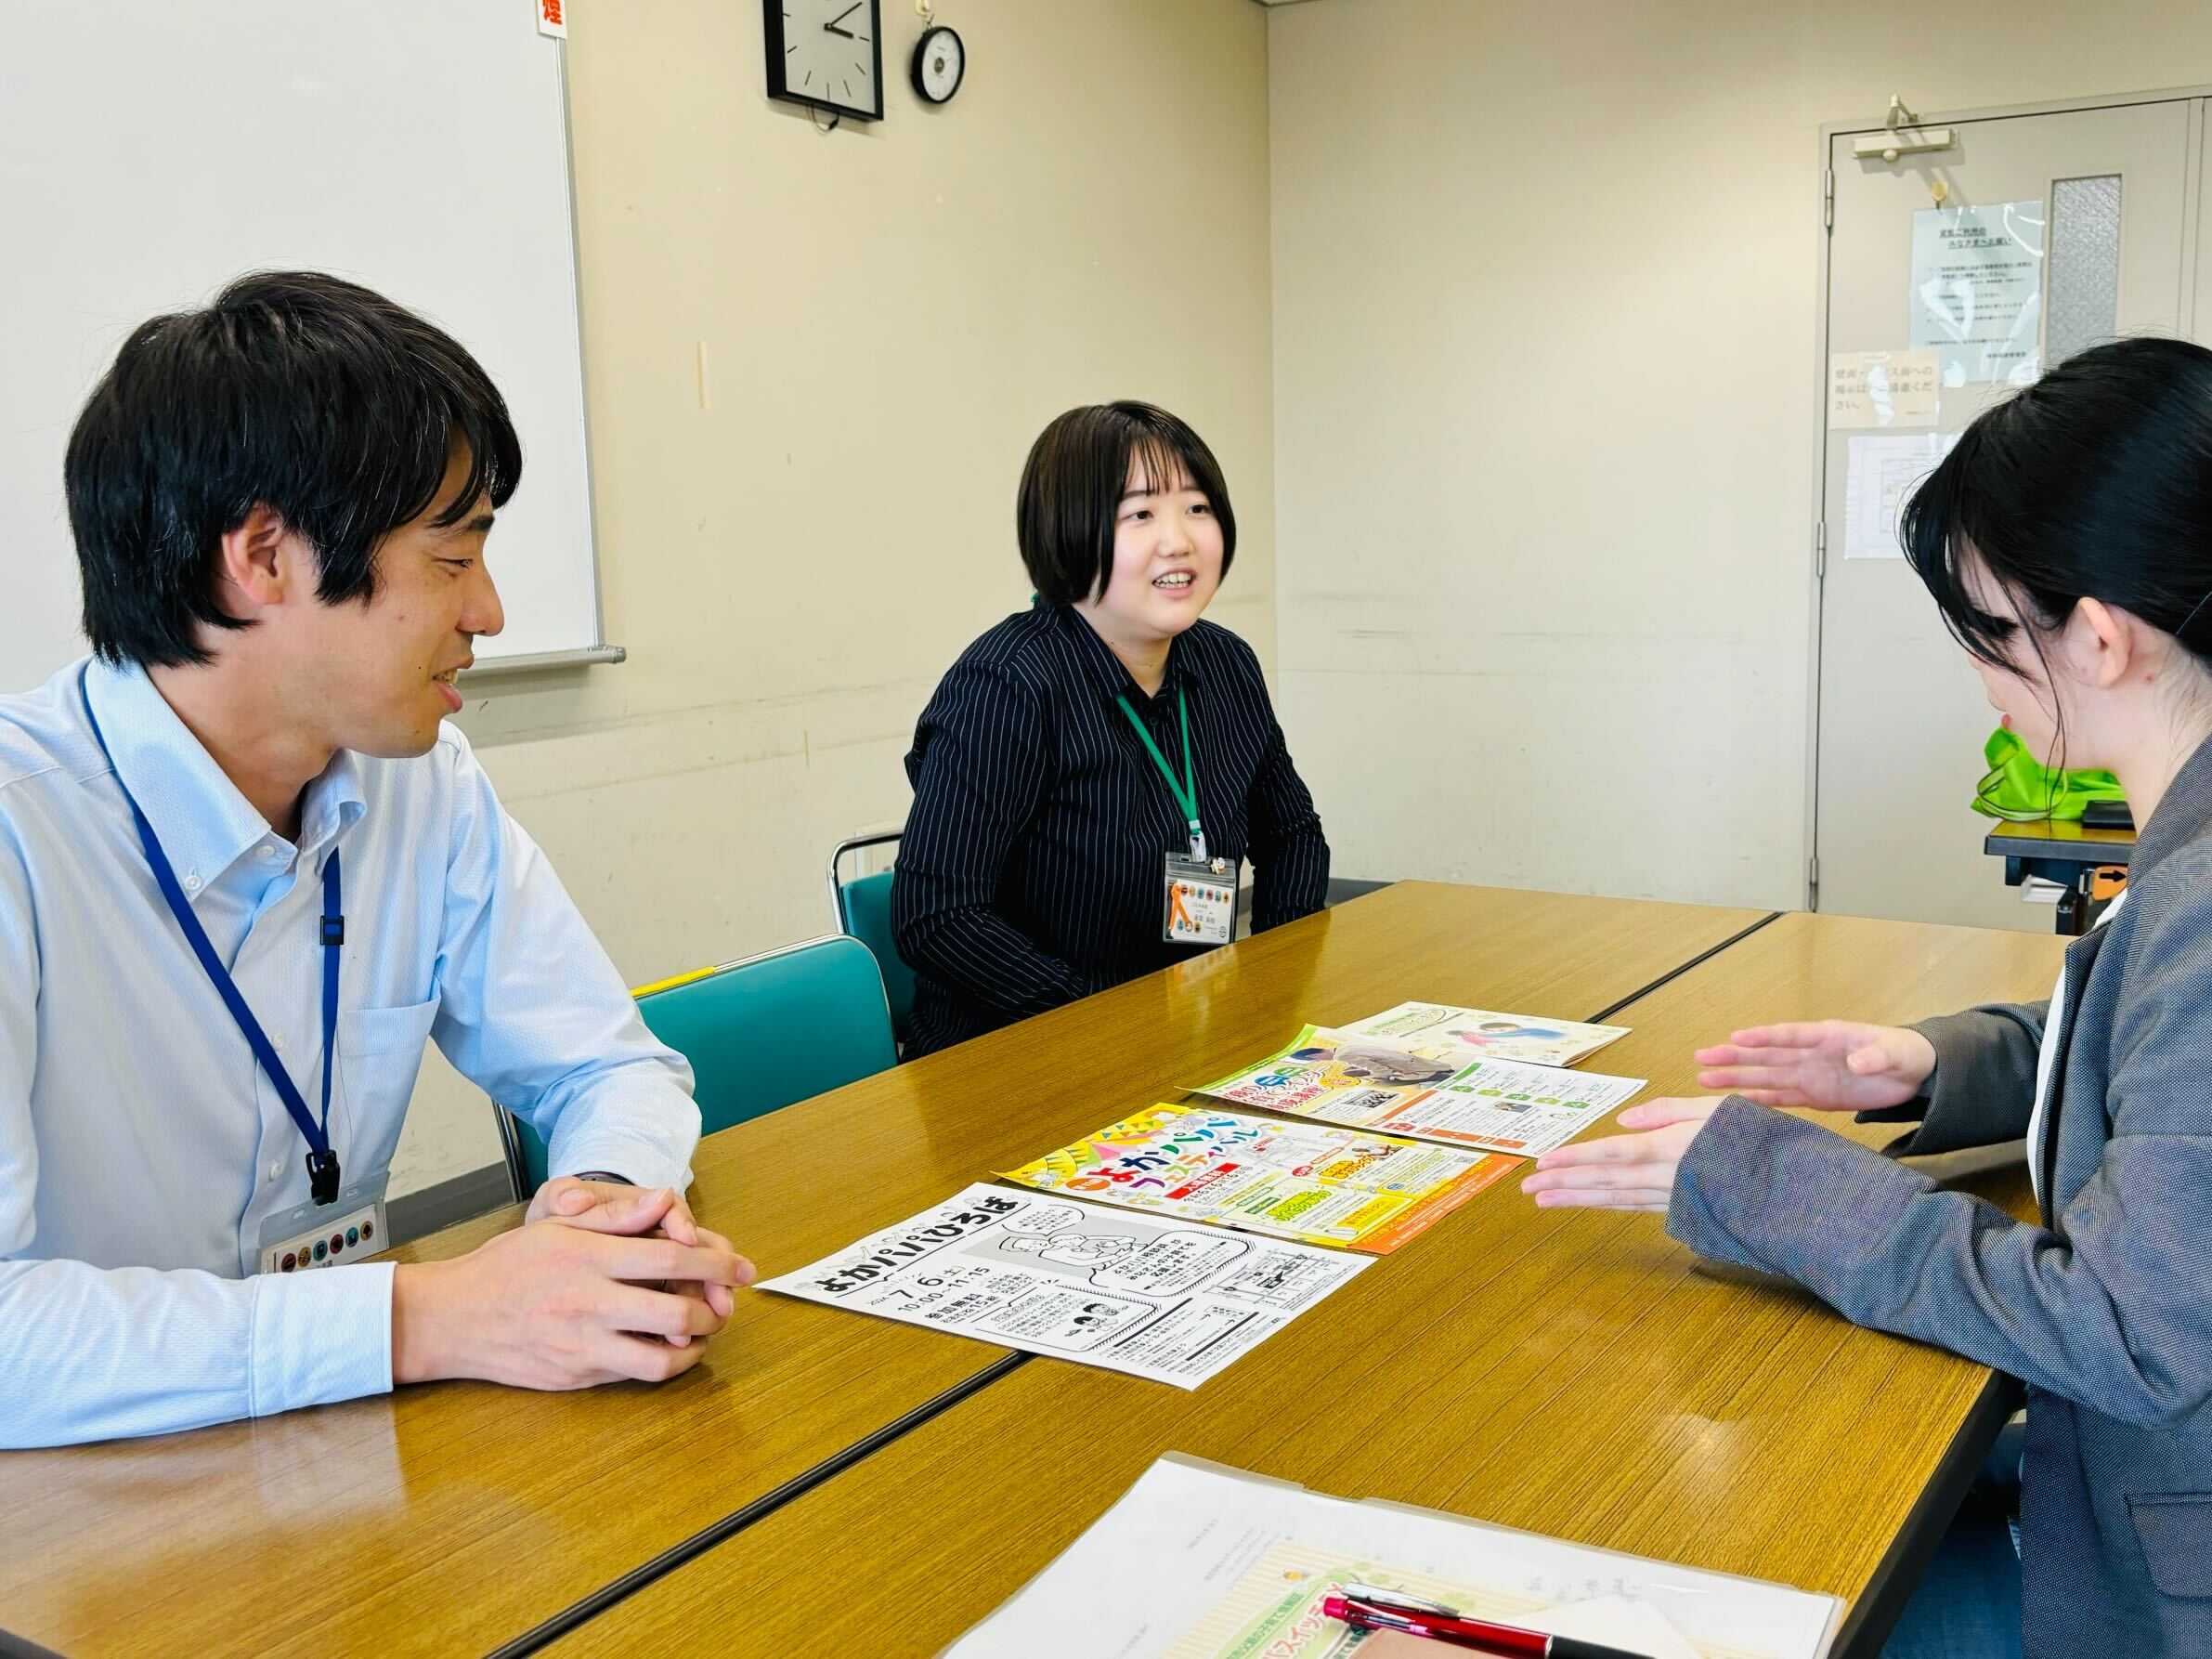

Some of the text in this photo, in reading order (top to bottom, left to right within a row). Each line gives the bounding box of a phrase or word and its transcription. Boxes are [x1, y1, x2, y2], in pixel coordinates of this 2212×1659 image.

[1086, 1117, 1238, 1182] よかパパ
[1129, 1129, 1258, 1188] フェスティバル
[814, 1196, 1019, 1293] よかパパひろば
[1126, 1242, 1196, 1280] みなさんの子育てを
[1151, 1253, 1196, 1276] 応援します。
[924, 1294, 980, 1320] 参加無料
